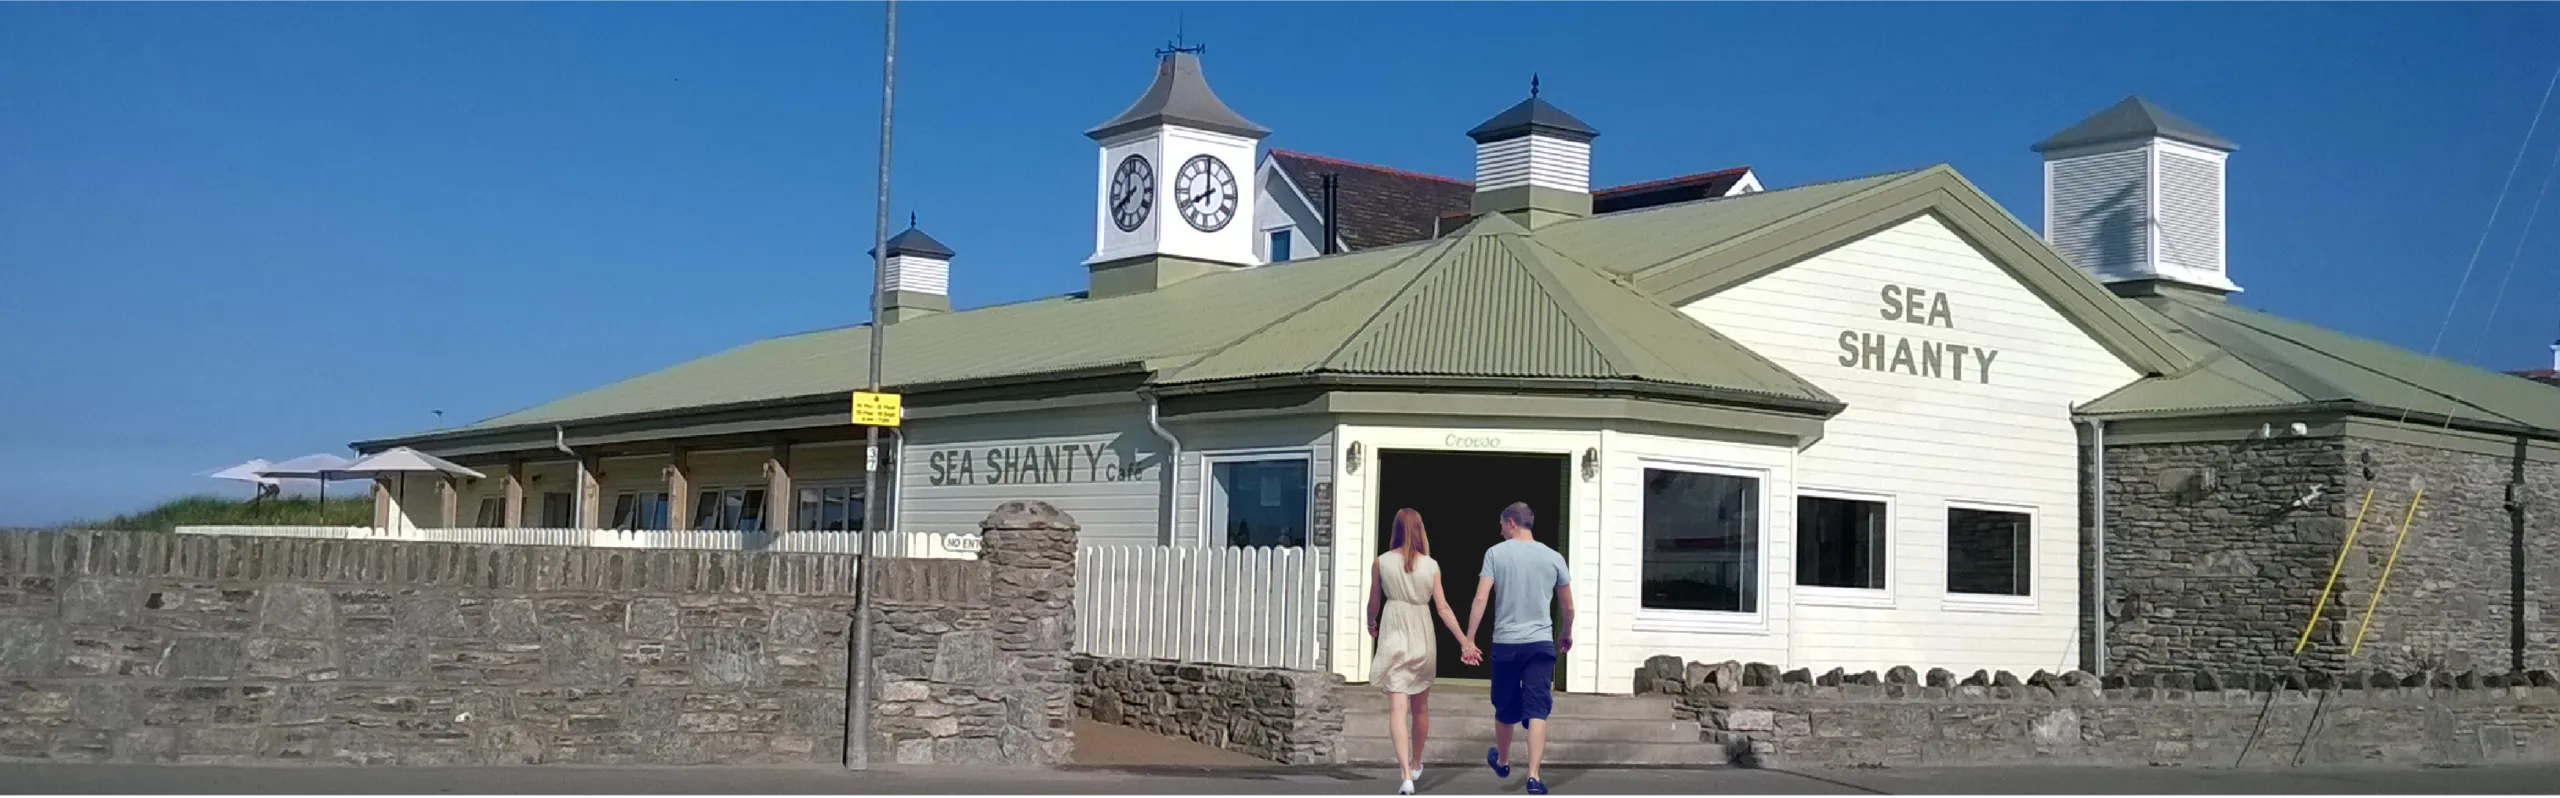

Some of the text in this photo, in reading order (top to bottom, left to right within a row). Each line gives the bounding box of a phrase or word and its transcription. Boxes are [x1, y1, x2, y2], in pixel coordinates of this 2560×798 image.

[1880, 284, 1954, 329] SEA
[1838, 330, 1998, 384] SHANTY
[929, 450, 974, 486] SEA
[986, 442, 1106, 485] SHANTY
[948, 538, 981, 549] NO ENT
